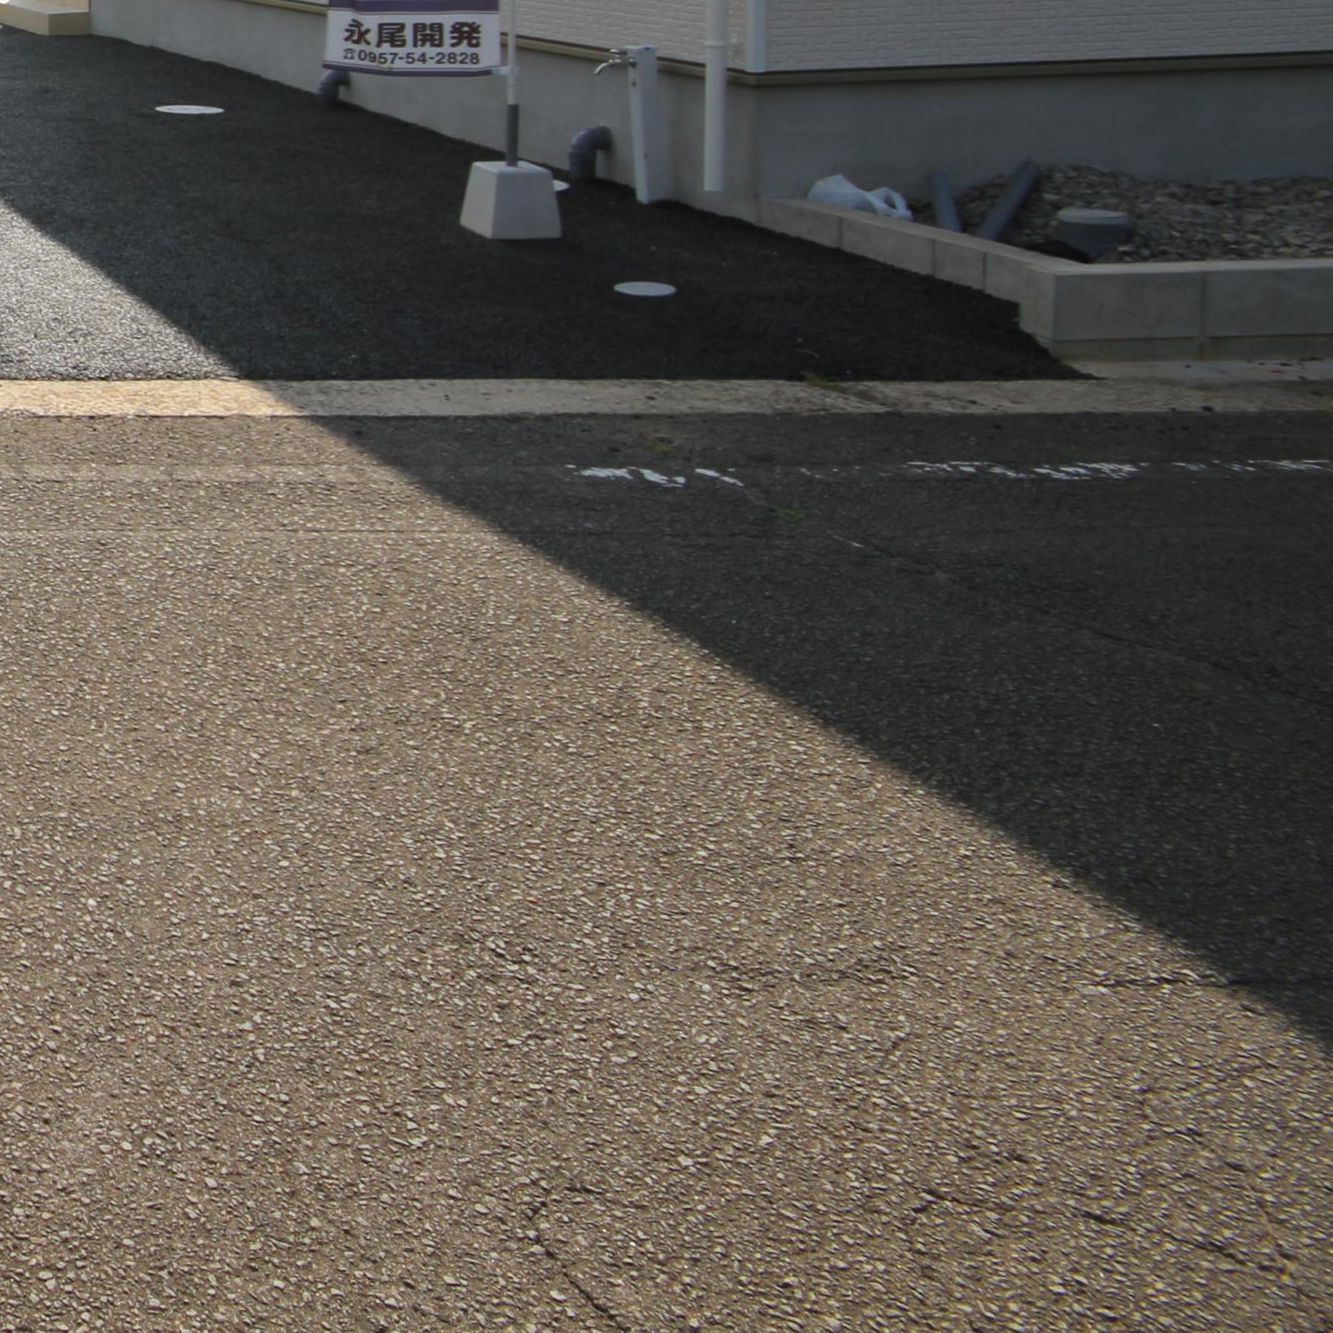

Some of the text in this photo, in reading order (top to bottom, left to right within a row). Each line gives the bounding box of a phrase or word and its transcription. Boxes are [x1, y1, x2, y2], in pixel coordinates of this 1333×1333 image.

[344, 18, 482, 48] 永尾開発
[358, 49, 480, 65] 0957-54-2828
